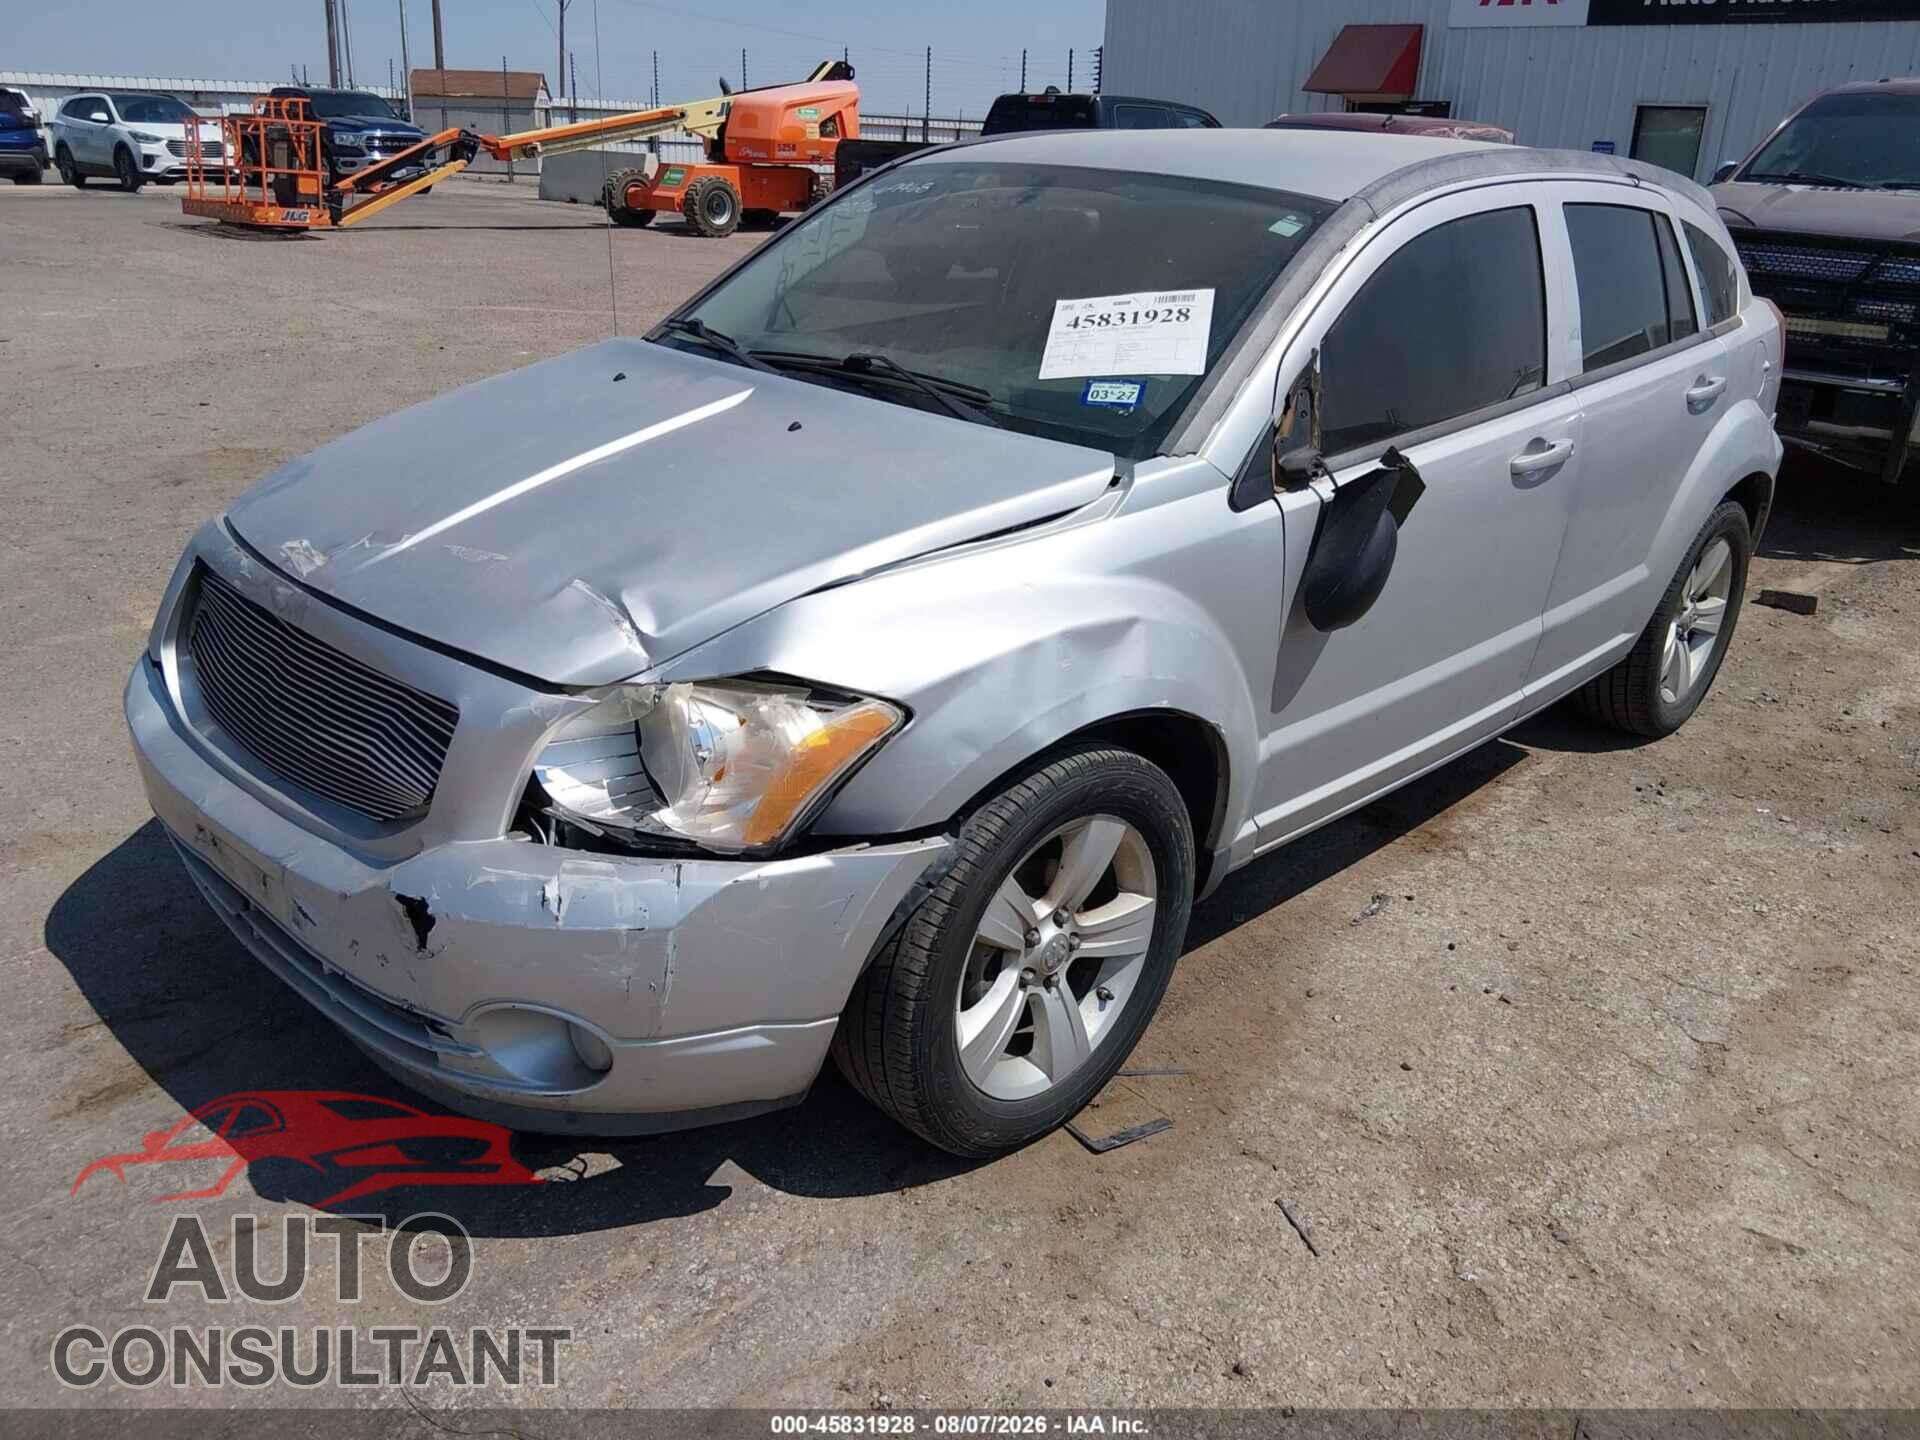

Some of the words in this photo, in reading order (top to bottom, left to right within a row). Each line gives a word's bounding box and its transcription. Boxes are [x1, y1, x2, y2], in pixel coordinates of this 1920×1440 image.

[1066, 308, 1191, 329] 45831928
[1090, 389, 1109, 400] 03
[1116, 390, 1136, 401] 27
